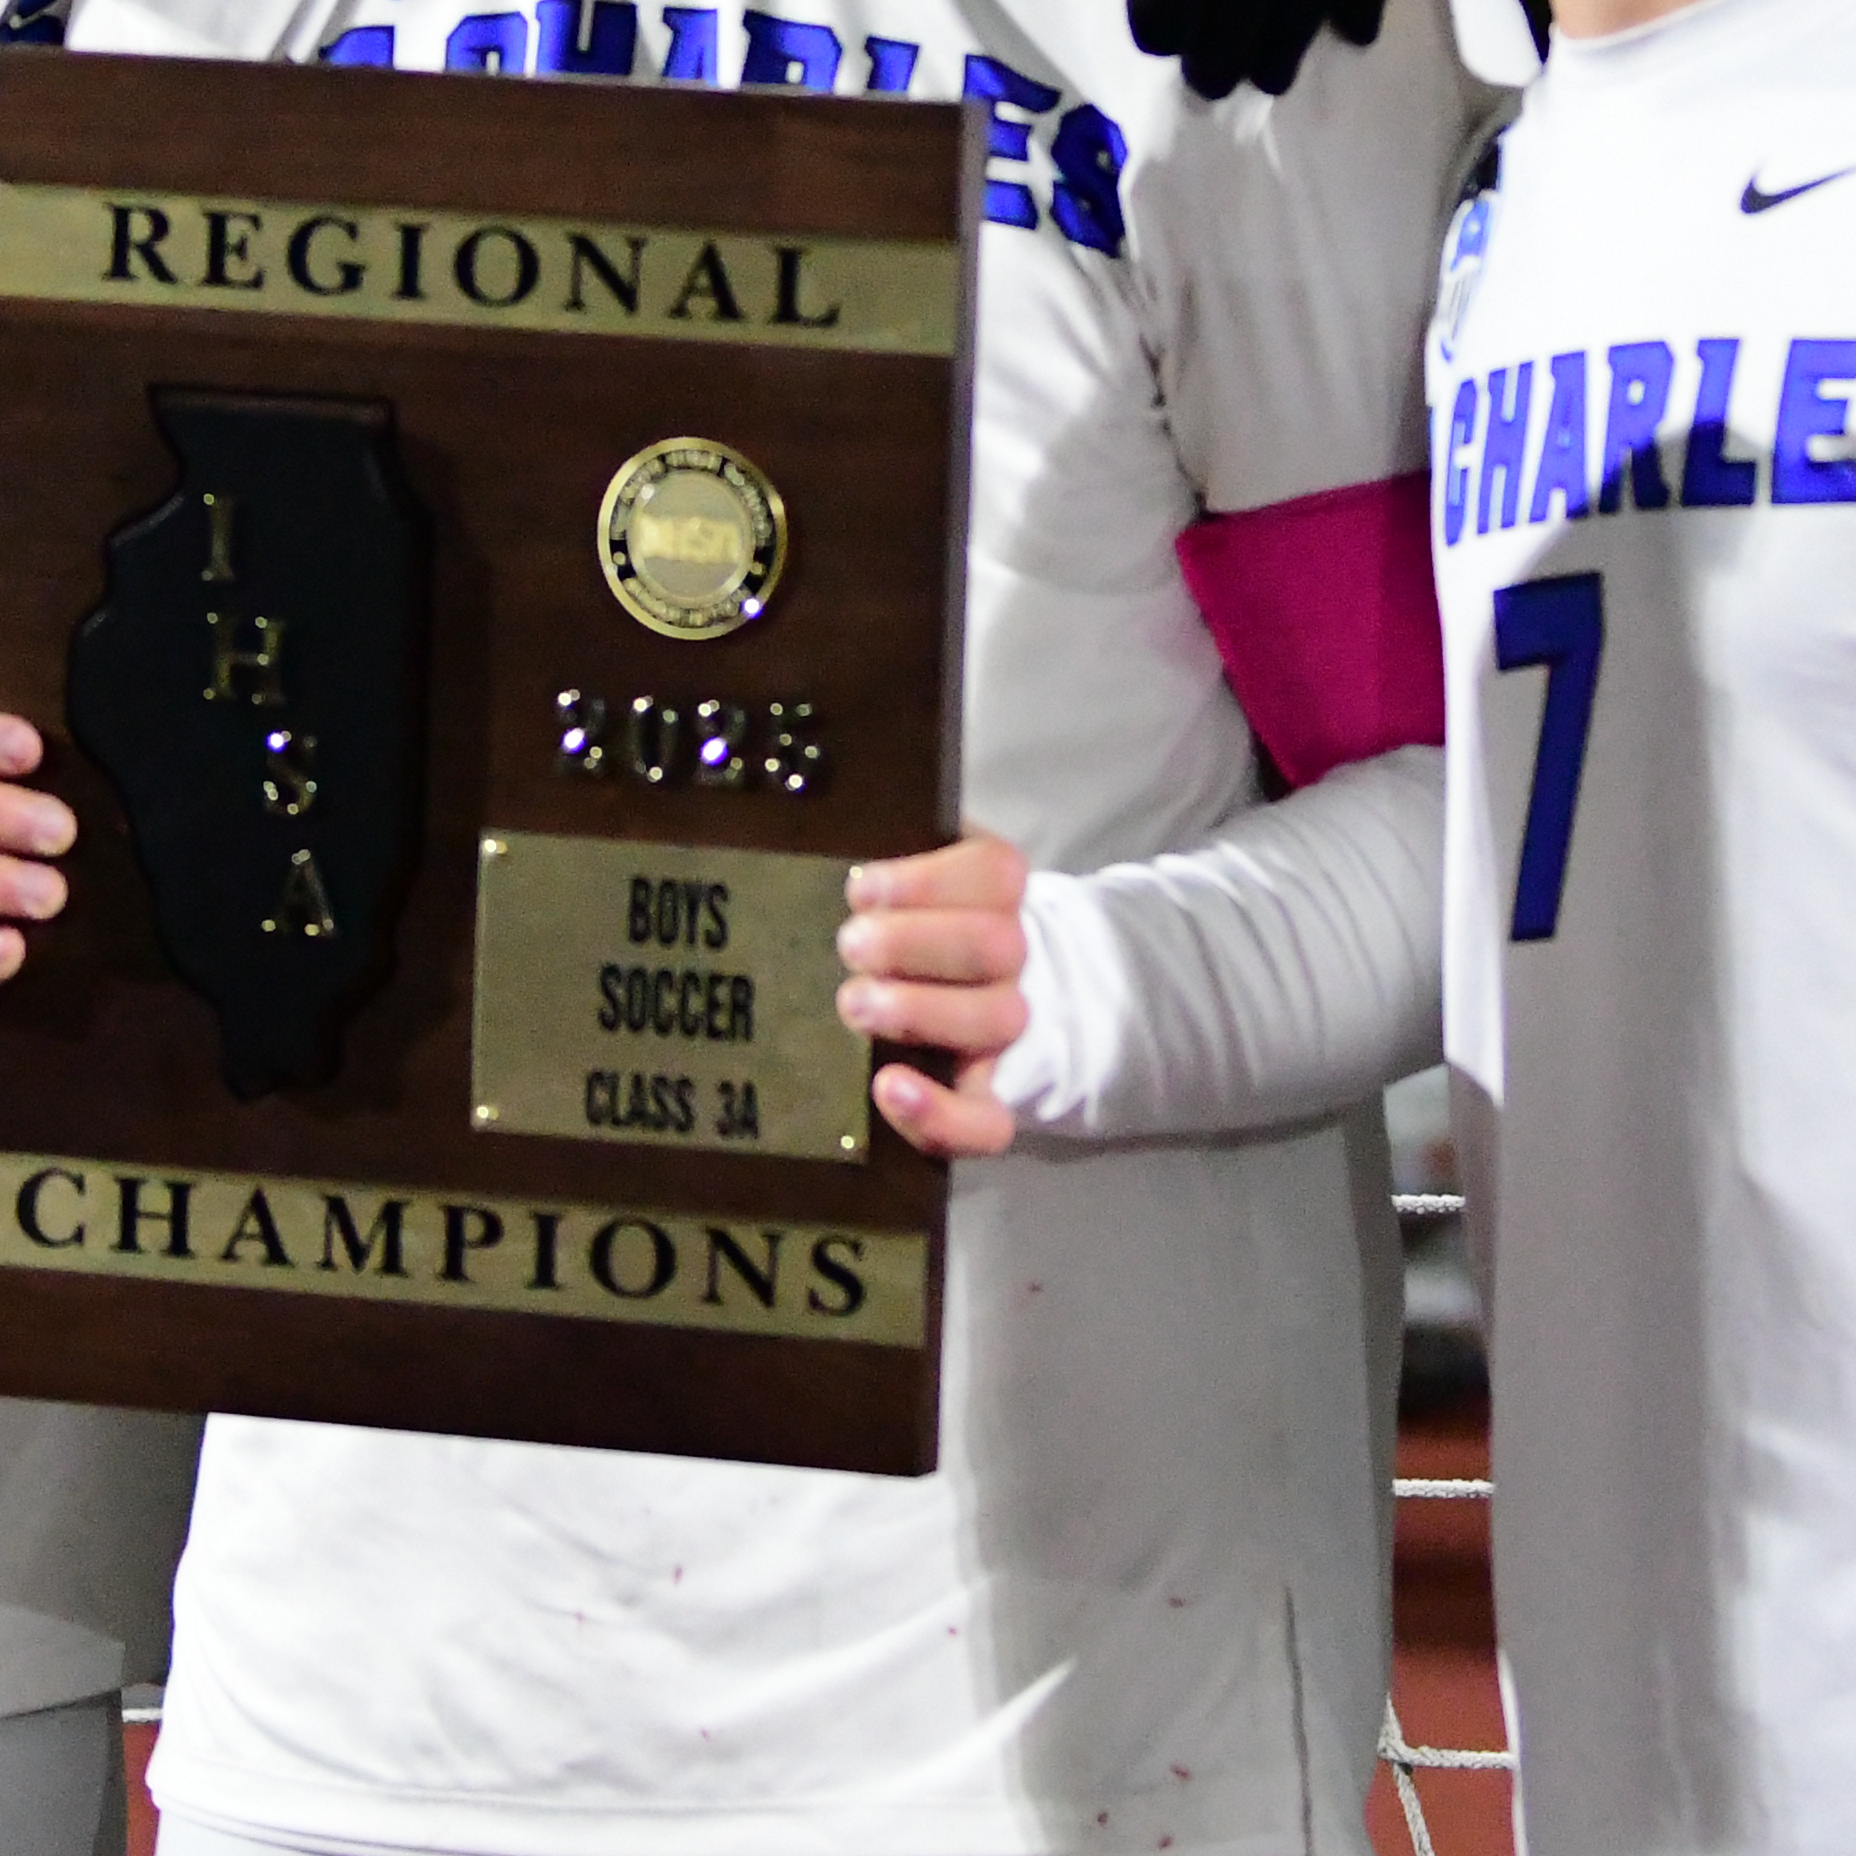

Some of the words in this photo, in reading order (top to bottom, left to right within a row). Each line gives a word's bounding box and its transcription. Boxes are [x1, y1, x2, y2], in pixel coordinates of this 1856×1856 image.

[102, 199, 845, 331] REGIONAL
[1493, 571, 1603, 944] 7
[628, 876, 730, 951] BOYS
[597, 960, 757, 1042] SOCCER
[585, 1068, 696, 1134] CLASS
[715, 1079, 760, 1141] 3A
[13, 1165, 872, 1320] CHAMPIONS
